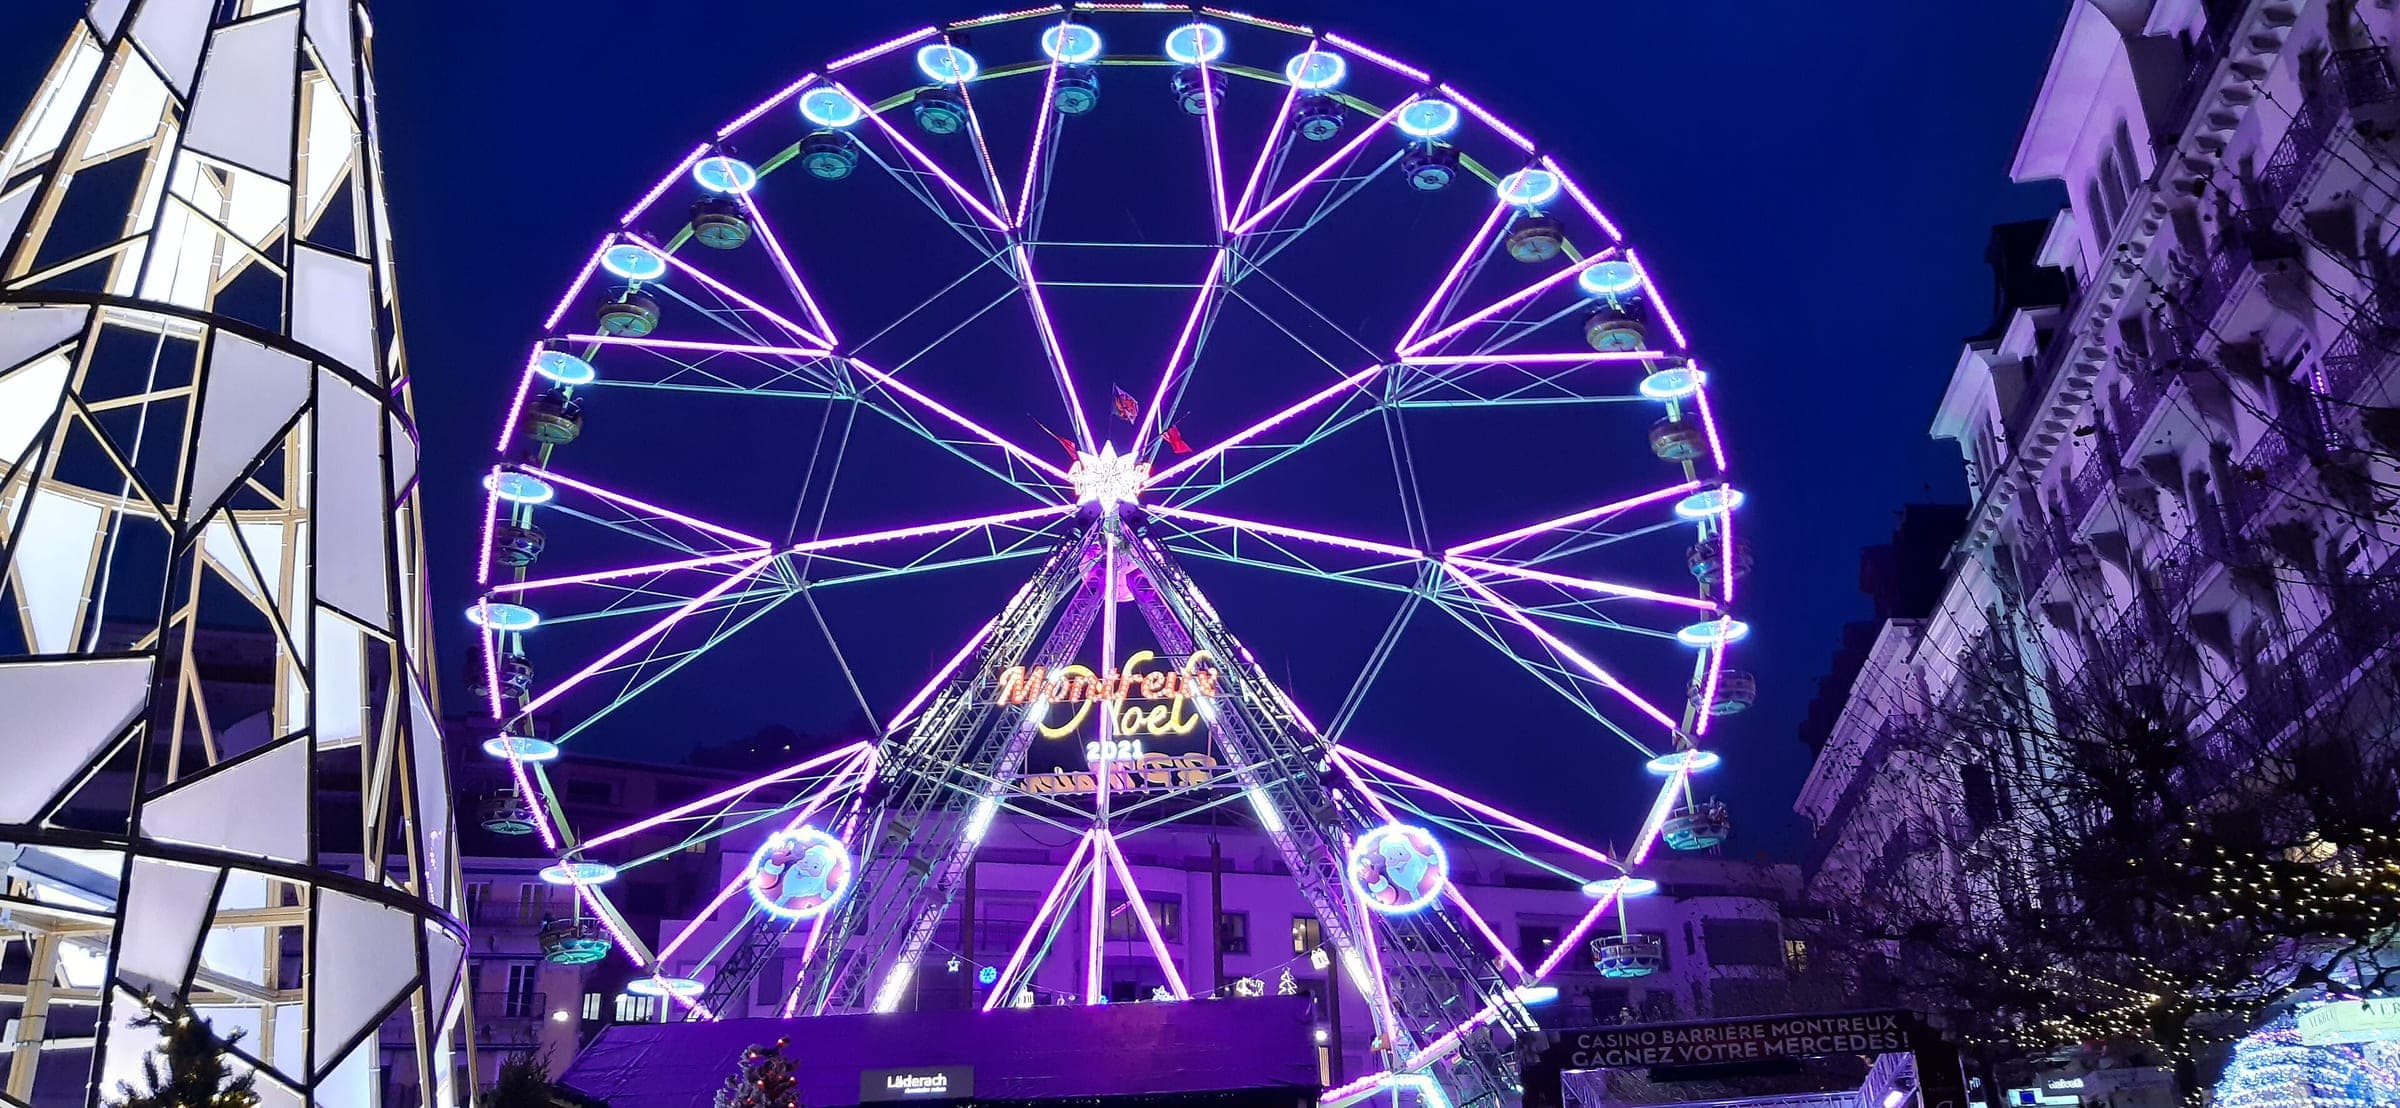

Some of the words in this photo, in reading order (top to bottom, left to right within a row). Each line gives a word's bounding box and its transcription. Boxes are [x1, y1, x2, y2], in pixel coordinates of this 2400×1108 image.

[998, 665, 1218, 706] Montreux
[1086, 739, 1143, 761] 2021
[1577, 1031, 1655, 1049] CASINO
[1664, 1022, 1765, 1045] BARRIÈRE
[1772, 1015, 1898, 1039] MONTREUX
[1571, 1046, 1675, 1067] GAGNEZ
[1679, 1040, 1759, 1061] VOTRE
[887, 1073, 948, 1088] Läderach
